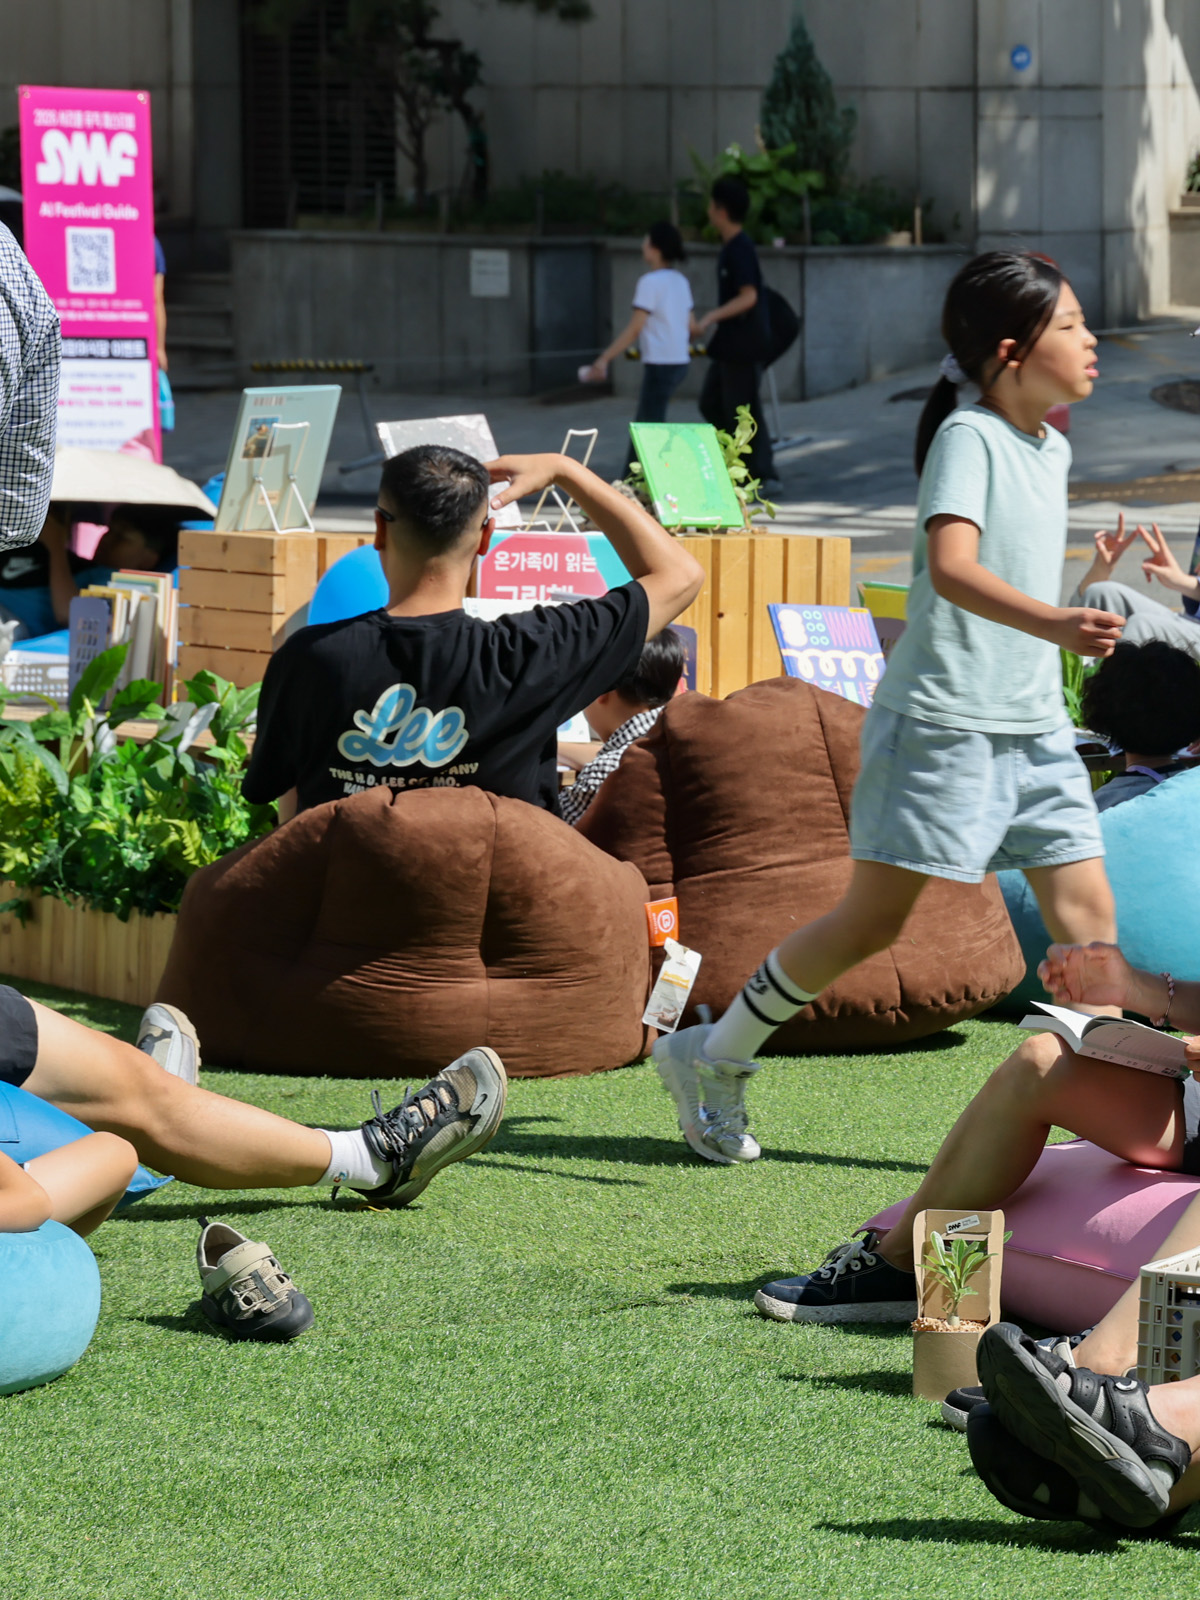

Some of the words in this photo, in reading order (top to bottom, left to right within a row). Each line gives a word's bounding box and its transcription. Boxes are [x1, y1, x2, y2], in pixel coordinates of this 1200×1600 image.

[36, 128, 138, 187] SMF
[55, 201, 101, 219] Festival
[102, 203, 139, 221] Guide
[494, 551, 559, 572] 온가족이
[565, 552, 597, 573] 읽는
[337, 683, 470, 768] Lee
[328, 767, 354, 782] THE
[380, 775, 406, 788] LEE
